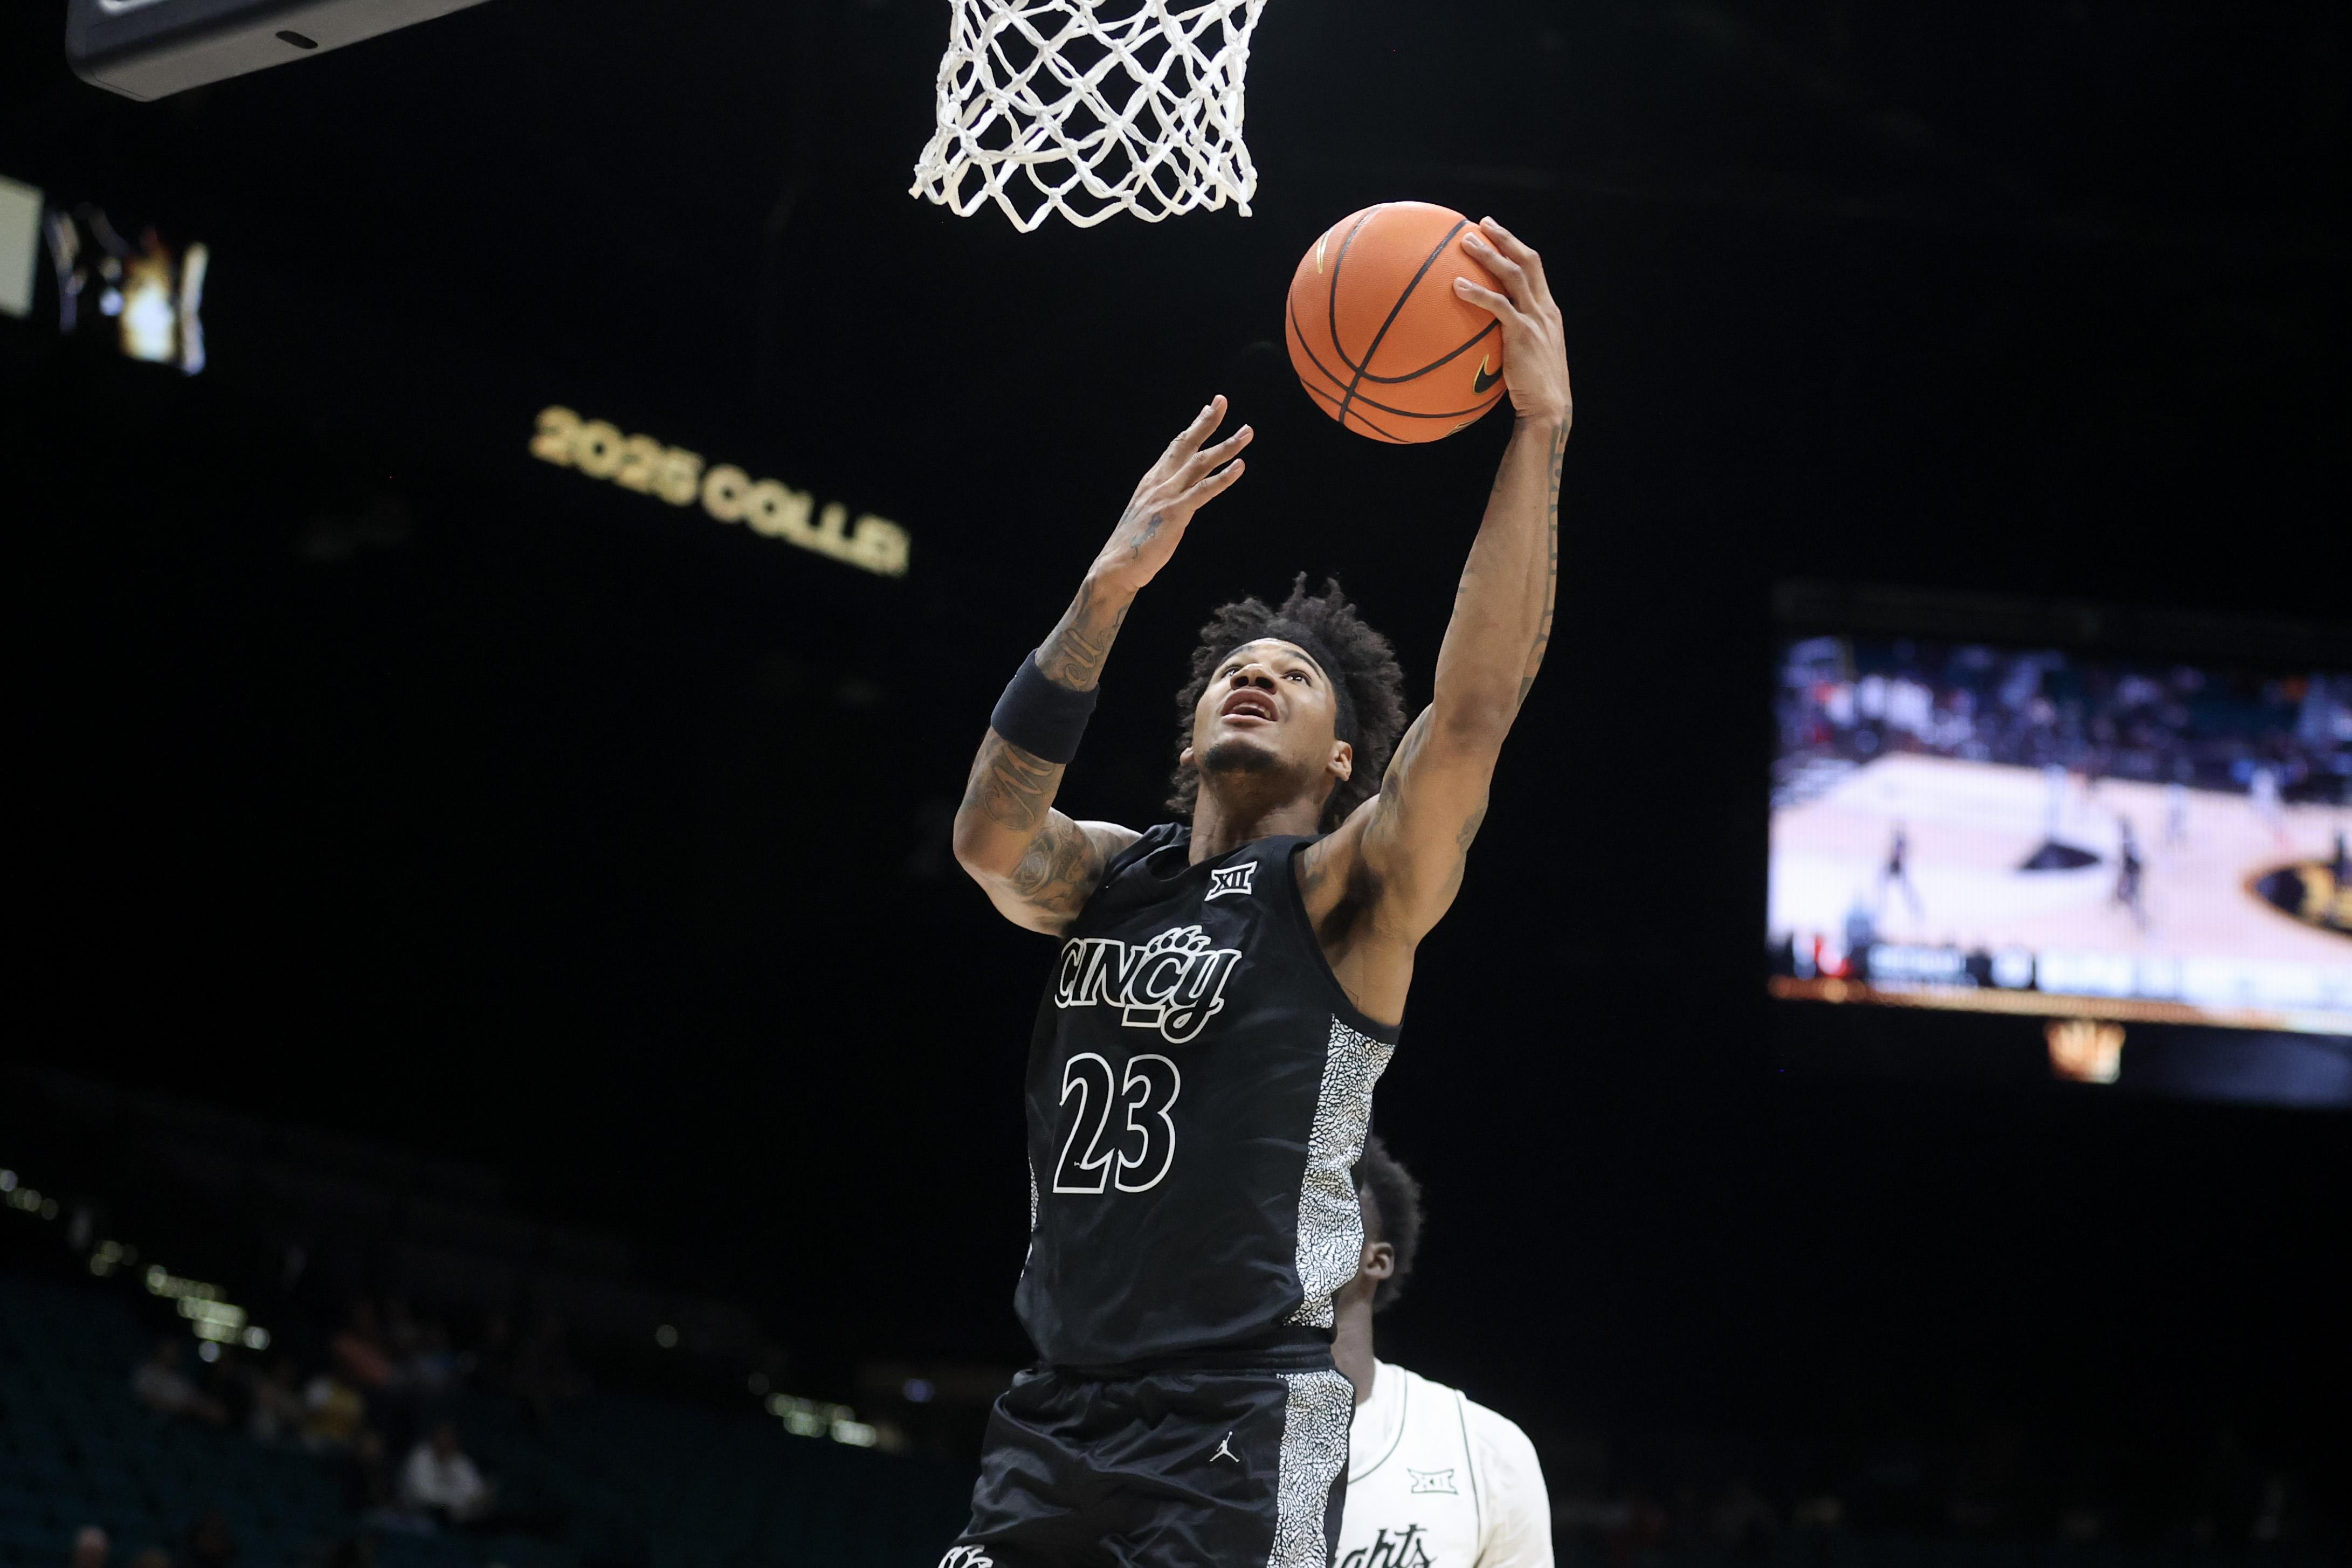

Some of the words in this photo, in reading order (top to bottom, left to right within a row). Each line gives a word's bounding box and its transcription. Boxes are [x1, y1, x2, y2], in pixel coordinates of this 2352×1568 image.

[531, 406, 702, 506] 2025
[1204, 861, 1258, 901] XII
[1053, 1052, 1181, 1194] 23
